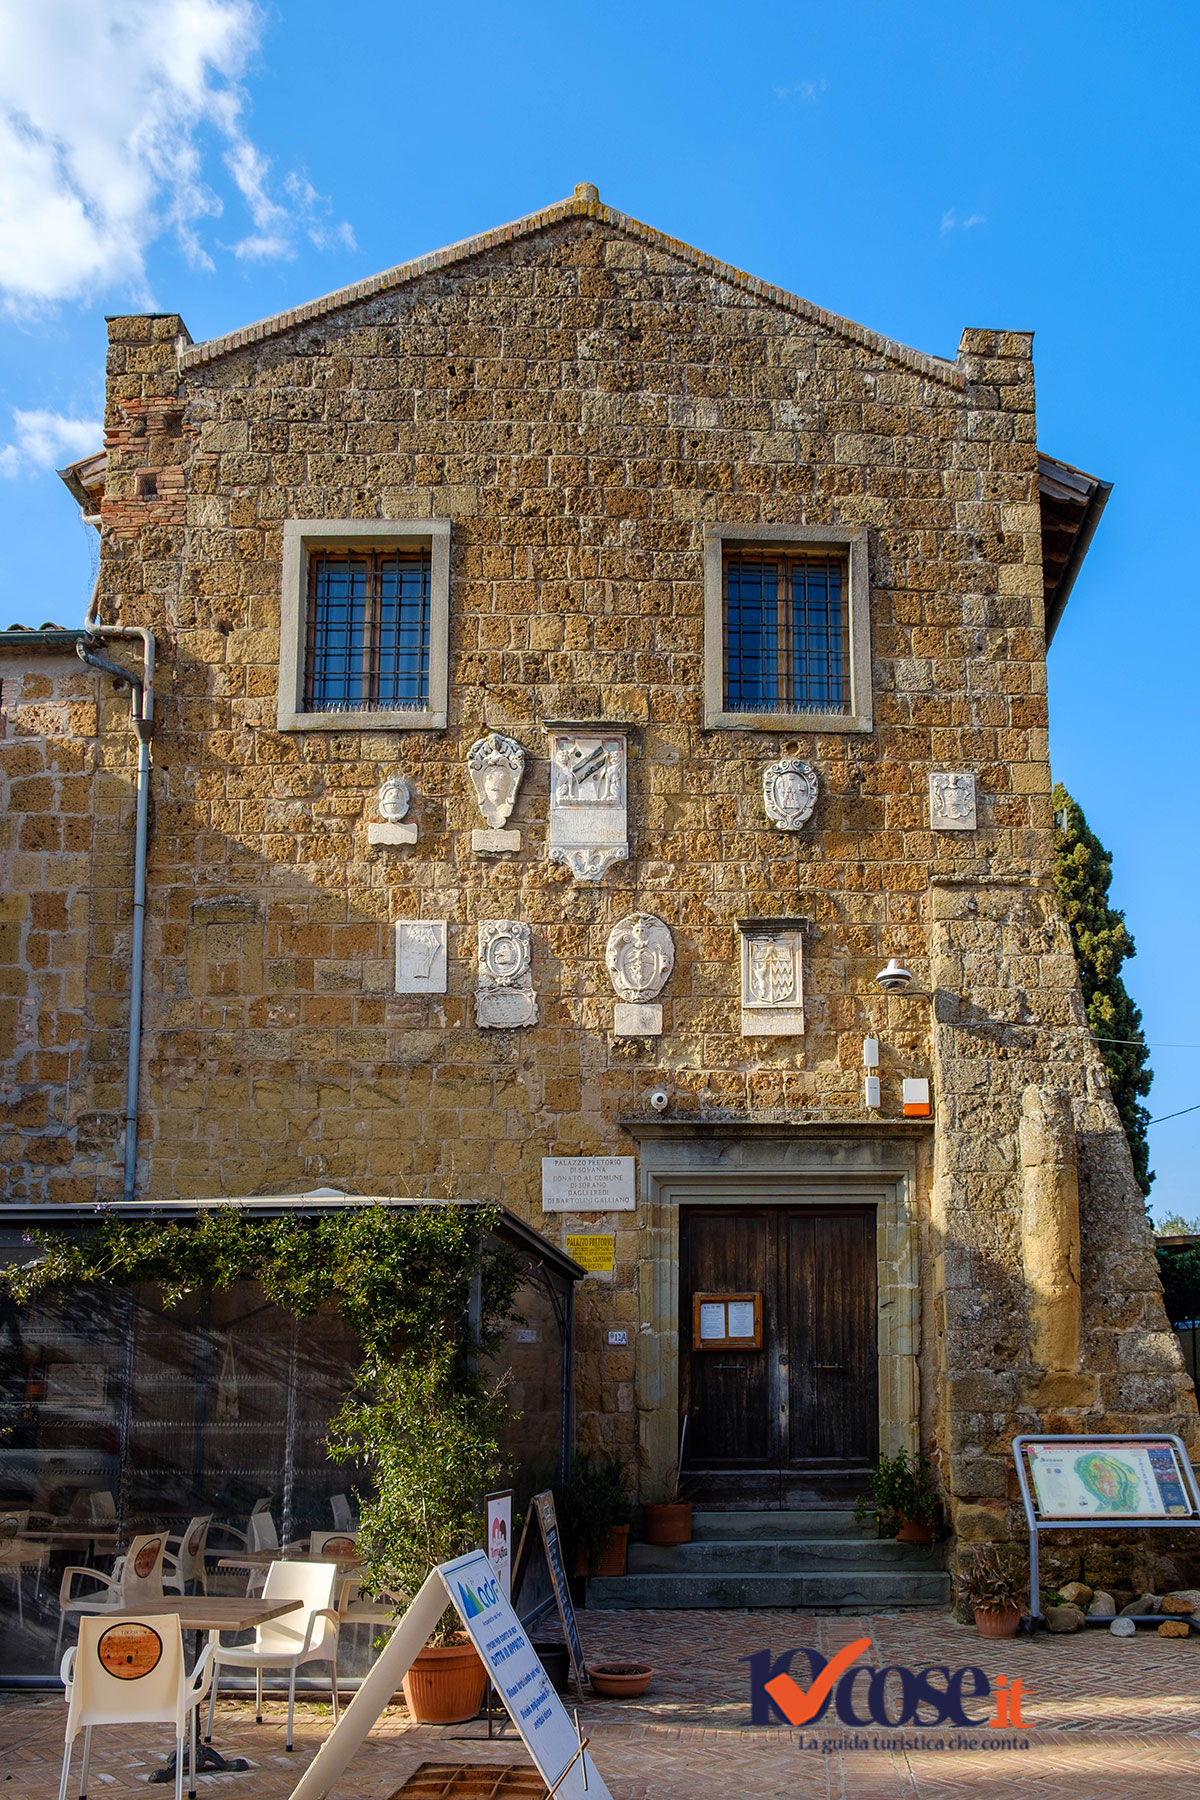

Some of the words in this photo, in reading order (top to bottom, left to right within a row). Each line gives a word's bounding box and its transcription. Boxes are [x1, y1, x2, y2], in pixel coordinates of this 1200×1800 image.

[567, 1237, 588, 1246] PALAZZO
[589, 1237, 613, 1246] PRETORIO
[615, 1333, 627, 1342] 12A
